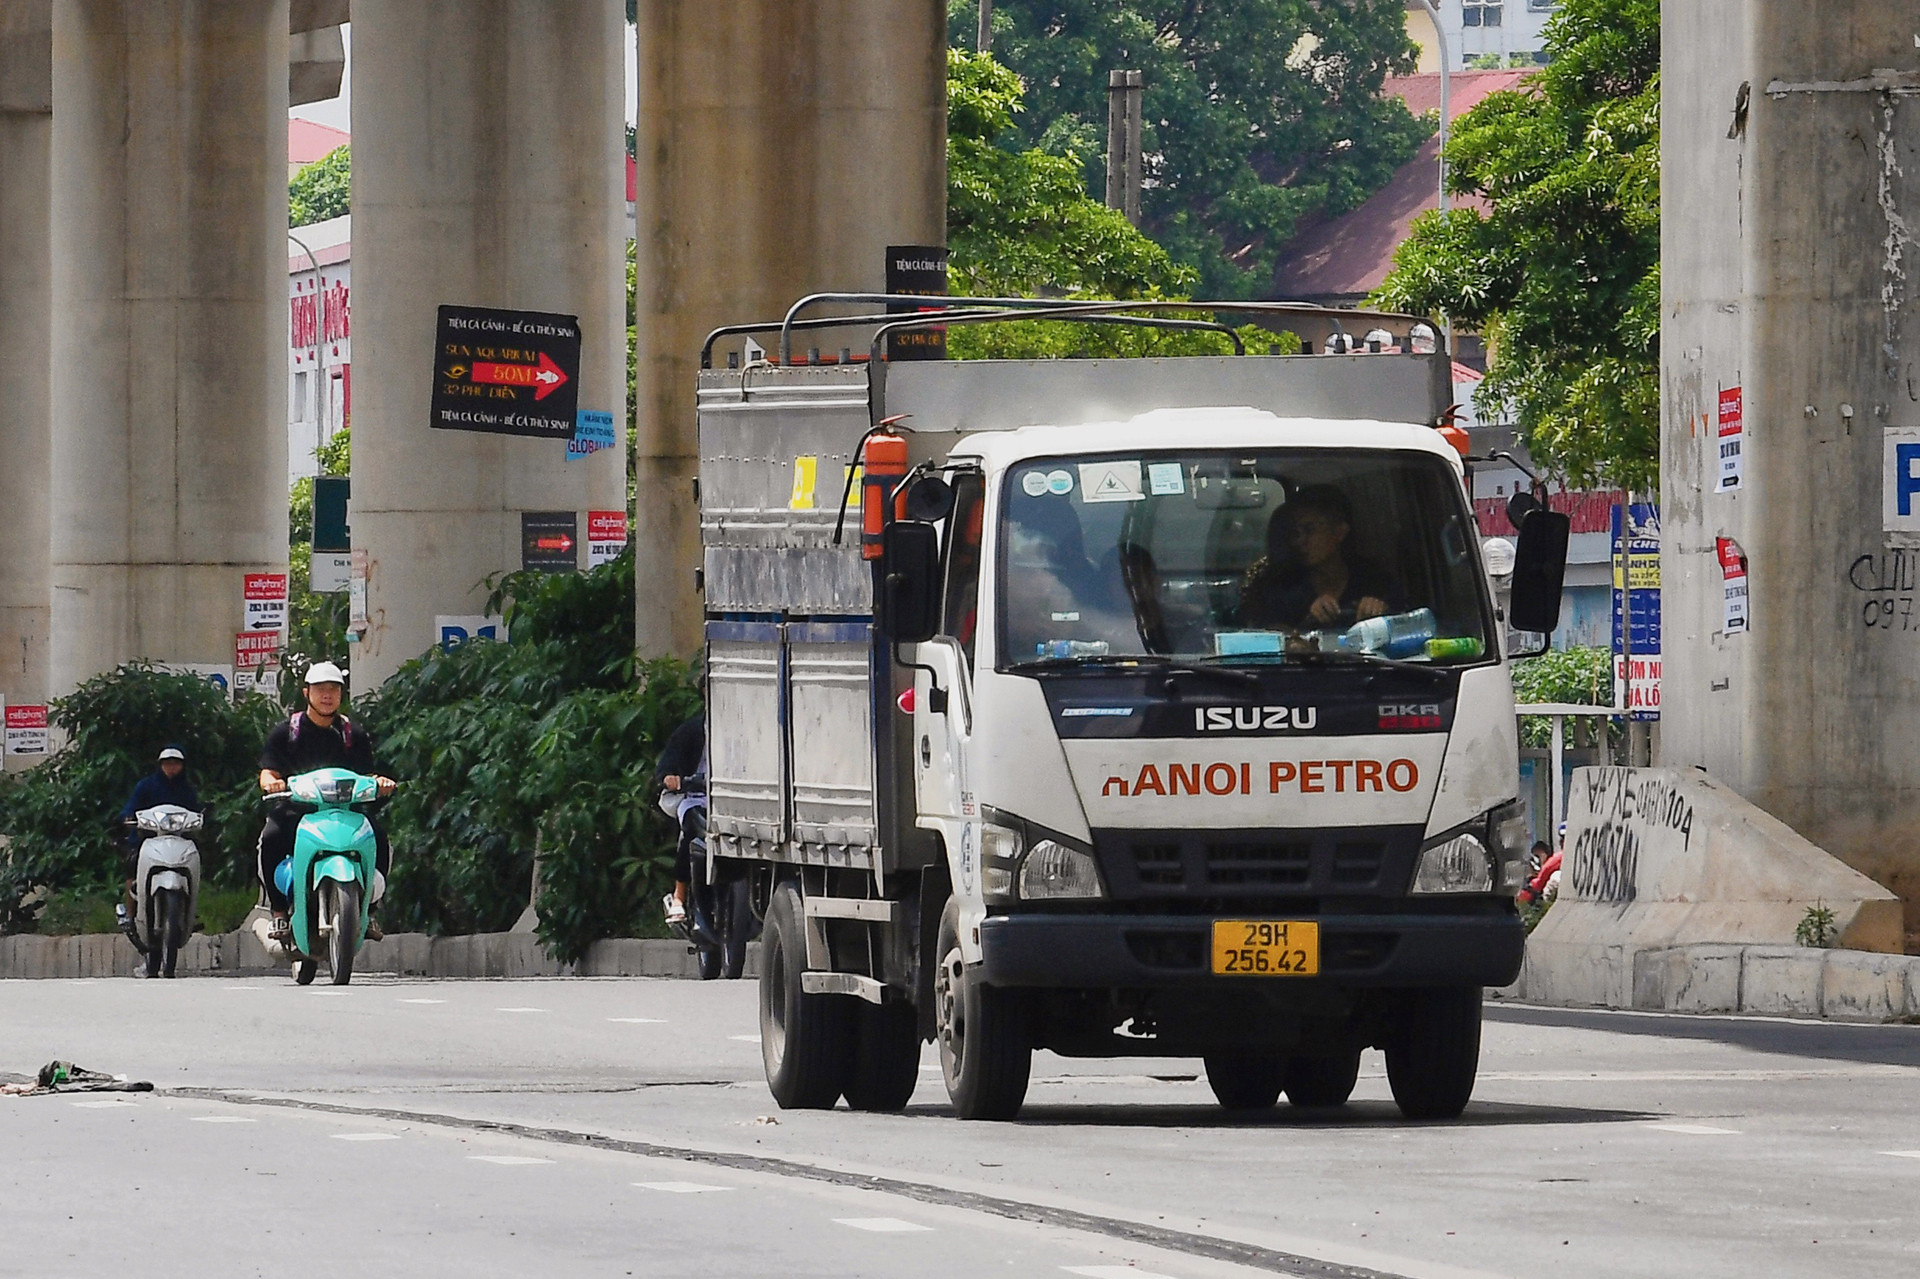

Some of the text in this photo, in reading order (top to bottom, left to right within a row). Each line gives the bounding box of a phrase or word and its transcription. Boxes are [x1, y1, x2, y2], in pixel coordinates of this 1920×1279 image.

[448, 317, 467, 329] TIỆM
[557, 328, 575, 338] SINH
[493, 366, 531, 382] 50M
[443, 384, 459, 395] 32
[441, 409, 459, 421] TIỆM
[550, 420, 569, 430] SINH
[1195, 706, 1316, 731] ISUZU
[1269, 759, 1419, 794] PETRO
[1244, 924, 1288, 946] 29H
[1225, 949, 1307, 972] 256.42
